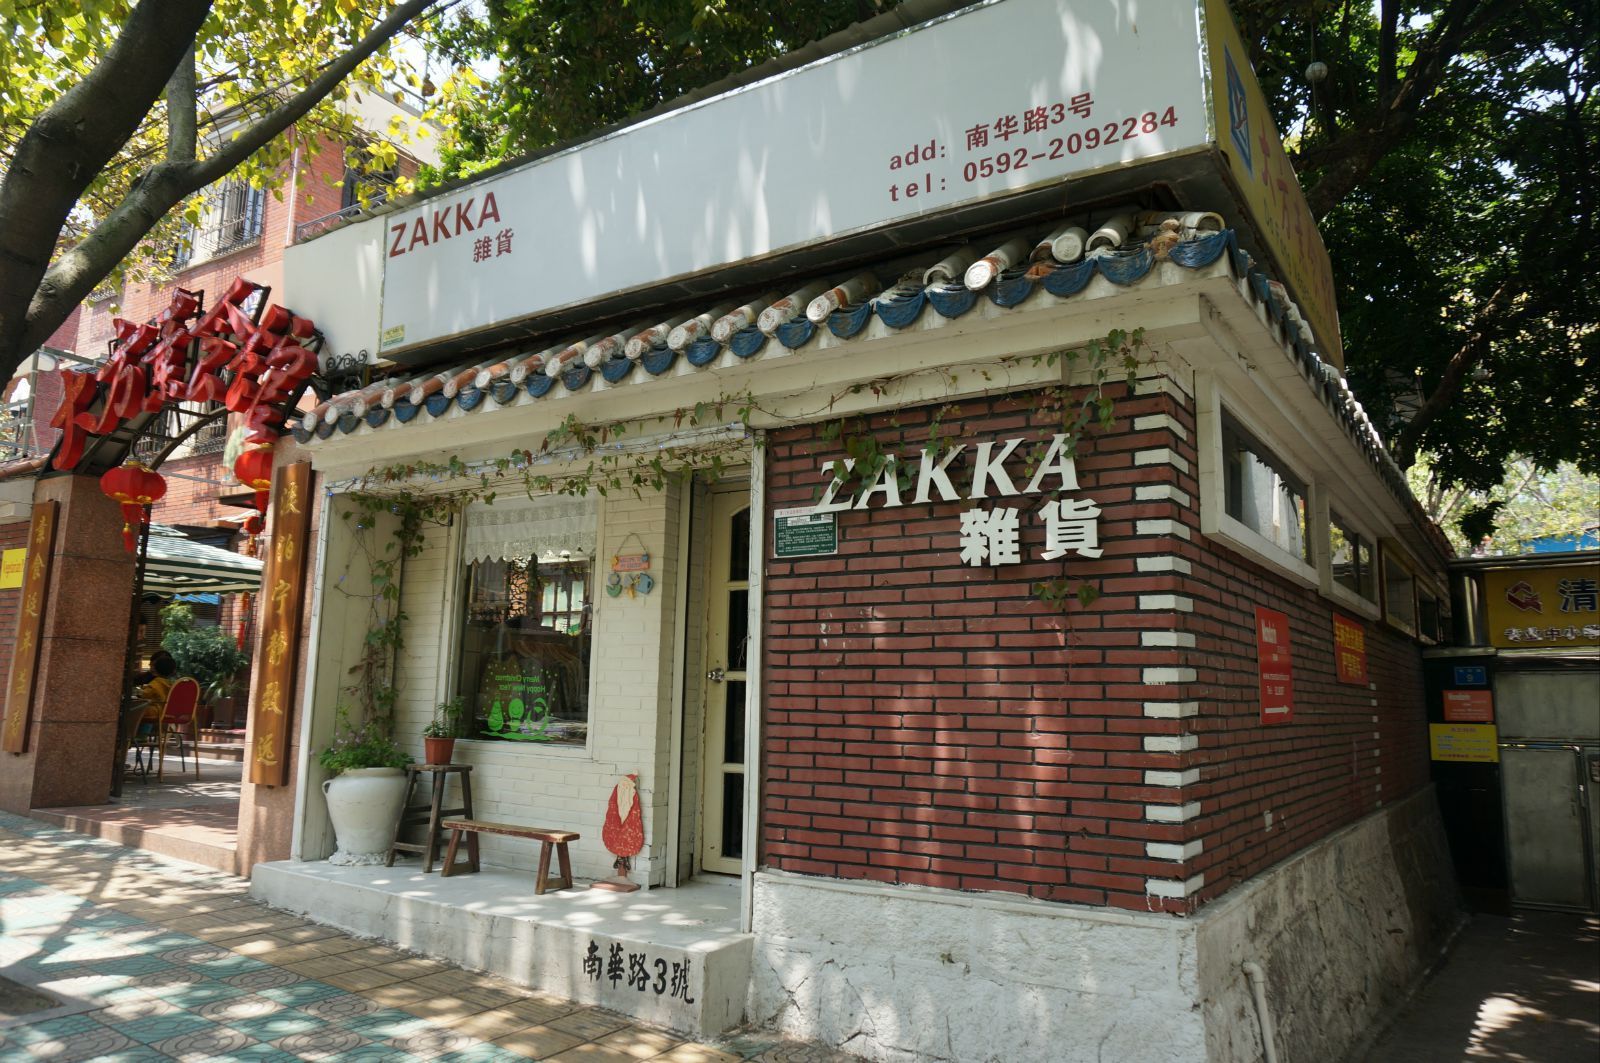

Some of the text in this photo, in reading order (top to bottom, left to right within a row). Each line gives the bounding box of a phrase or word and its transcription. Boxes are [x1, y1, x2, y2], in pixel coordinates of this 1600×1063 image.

[889, 91, 1095, 171] add: 南华路3号
[889, 105, 1179, 202] tel: 0592-2092284
[389, 190, 502, 259] ZAKKA
[472, 227, 515, 264] 雜貨
[813, 432, 1081, 515] ZAKKA
[959, 497, 1104, 567] 雜貨
[1557, 577, 1600, 613] 清
[583, 939, 695, 1004] 南華路3號
